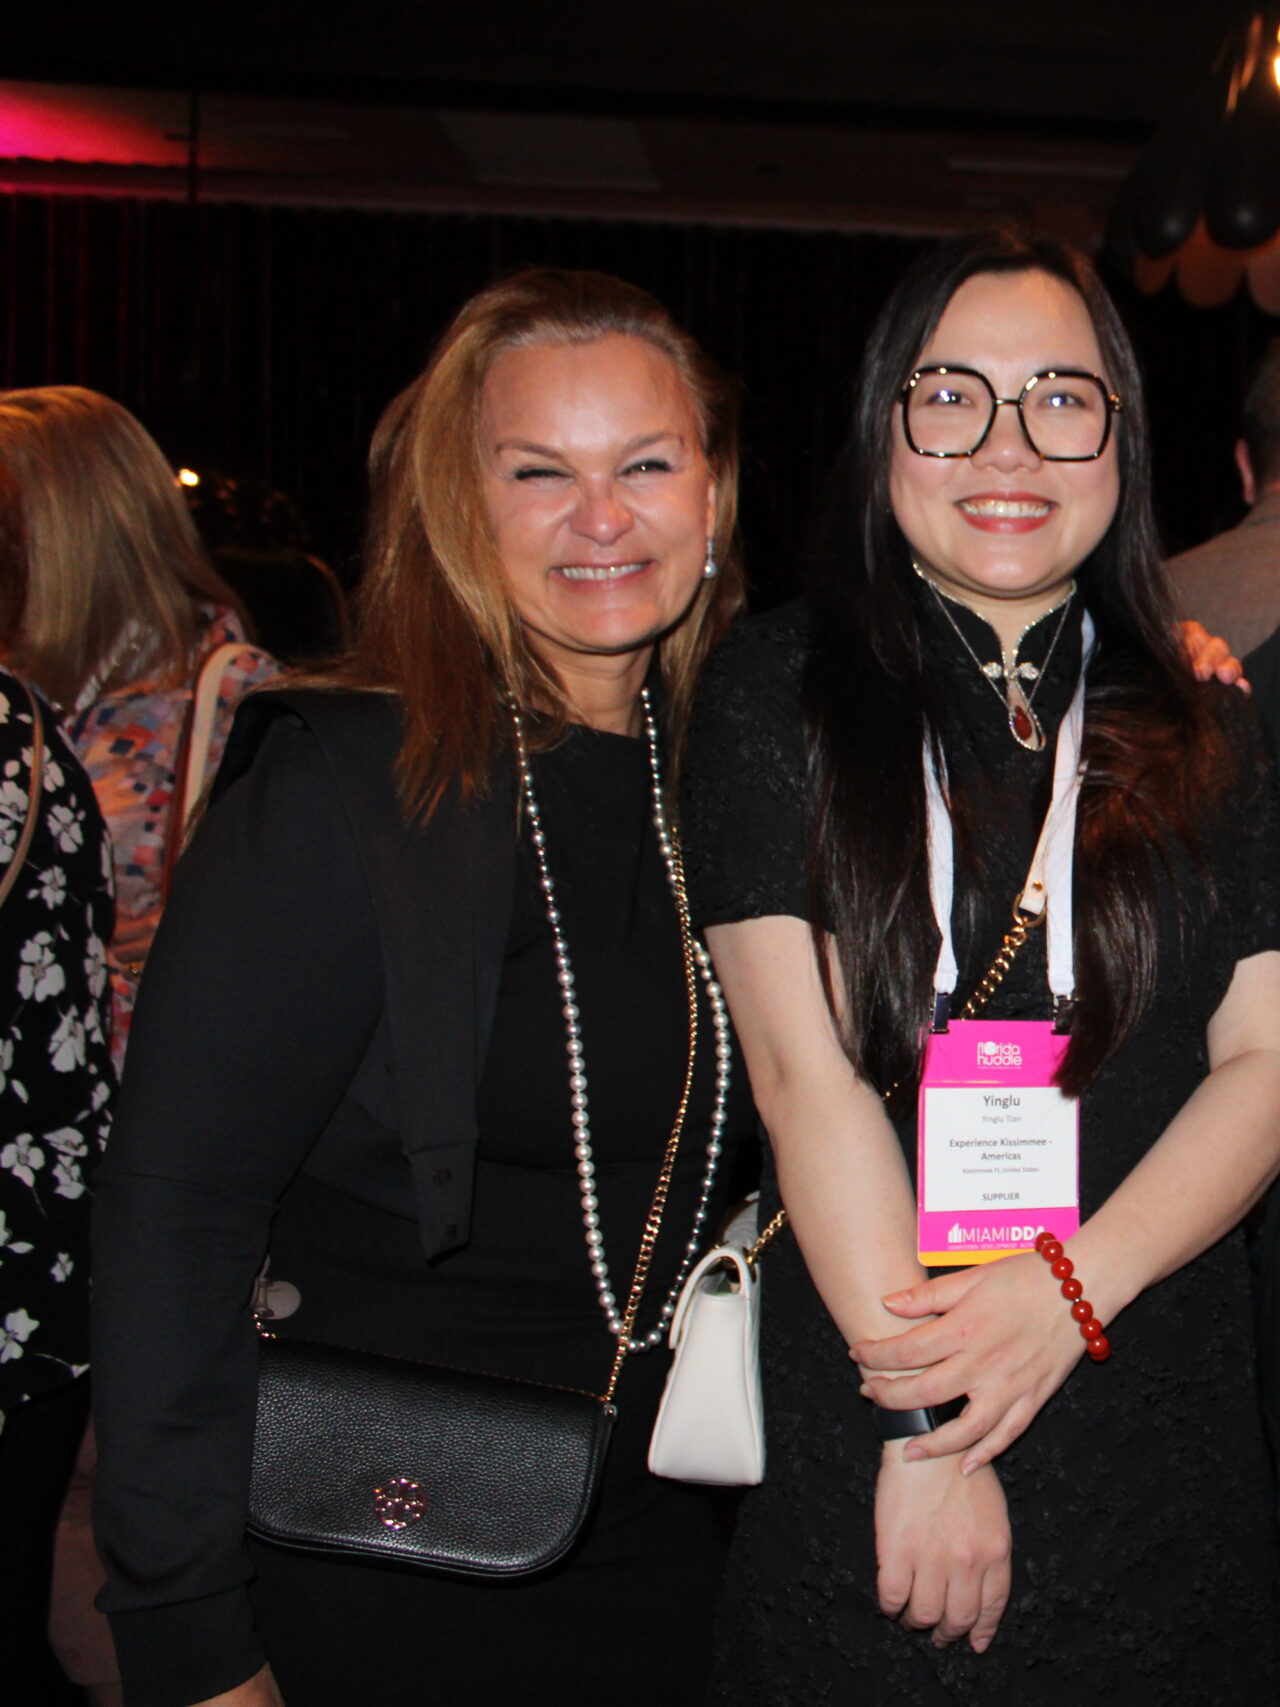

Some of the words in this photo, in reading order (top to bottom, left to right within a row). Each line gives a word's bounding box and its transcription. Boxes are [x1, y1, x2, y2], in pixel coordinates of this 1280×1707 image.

[977, 1041, 1021, 1055] florida
[977, 1053, 1023, 1066] huddle
[983, 1095, 1021, 1109] Yinglu
[981, 1114, 1005, 1125] Yinglu
[1006, 1114, 1022, 1123] Tian
[949, 1137, 999, 1148] Experience
[1000, 1137, 1047, 1147] Kissimmee
[981, 1151, 1022, 1161] Americas
[982, 1191, 1021, 1202] SUPPLIER
